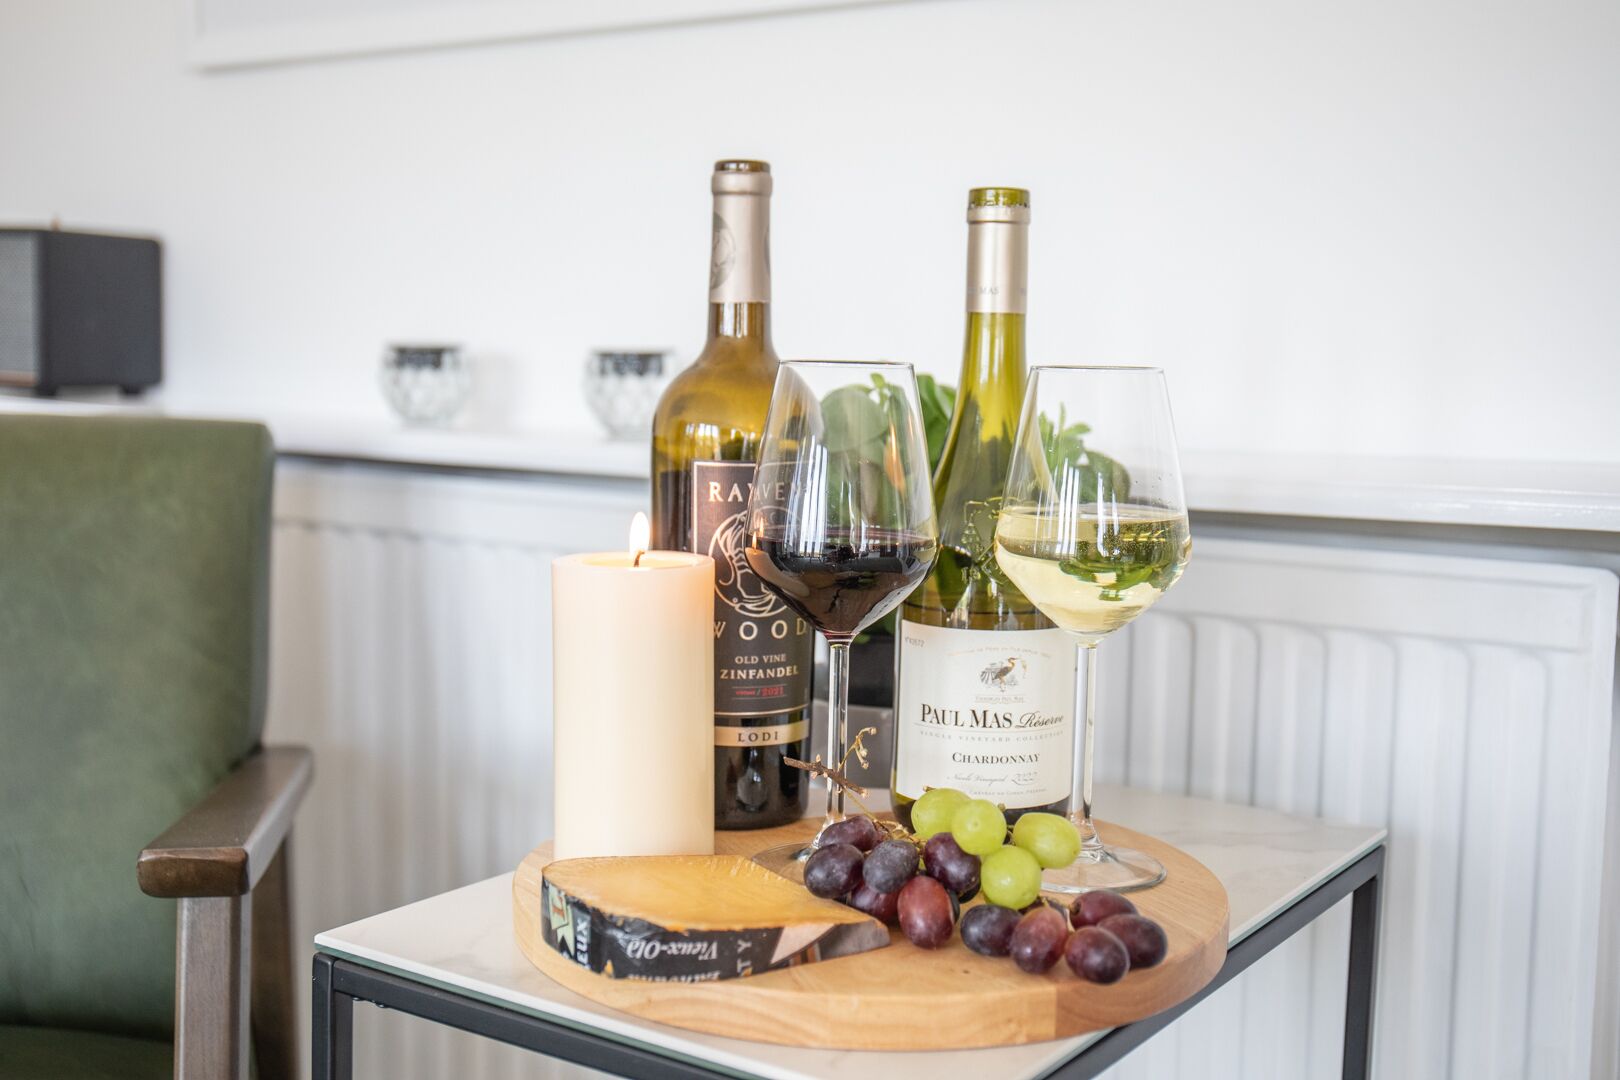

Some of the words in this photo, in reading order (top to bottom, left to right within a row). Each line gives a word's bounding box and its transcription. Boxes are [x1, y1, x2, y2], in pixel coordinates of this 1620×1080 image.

[713, 617, 807, 641] WOOD
[735, 655, 759, 665] OLD
[762, 653, 787, 663] VINE
[720, 665, 799, 680] ZINFANDEL
[921, 703, 965, 727] PAUL
[970, 709, 1013, 729] MAS
[1015, 710, 1064, 729] Réserve
[737, 731, 779, 742] LODI
[952, 751, 1041, 765] CHARDONNAY
[626, 939, 718, 961] Vieux-Old
